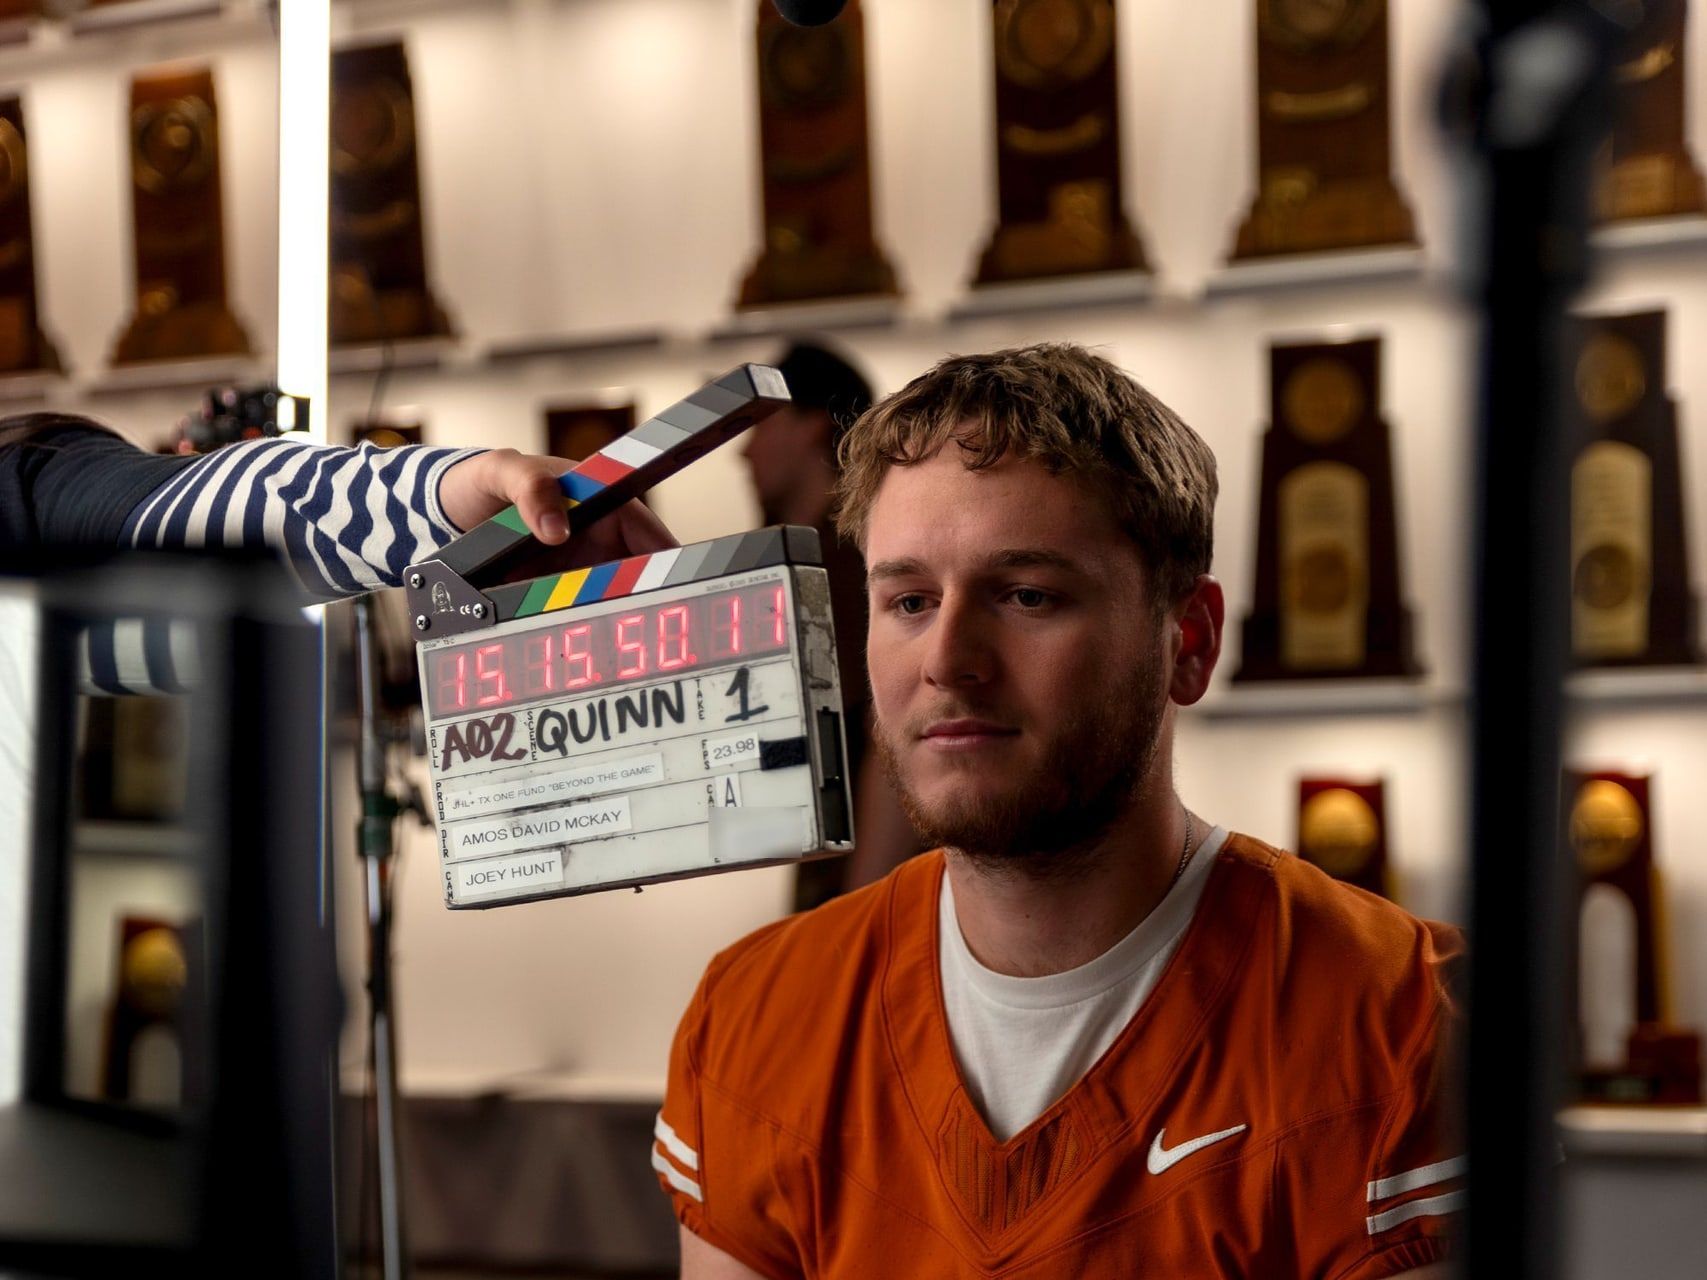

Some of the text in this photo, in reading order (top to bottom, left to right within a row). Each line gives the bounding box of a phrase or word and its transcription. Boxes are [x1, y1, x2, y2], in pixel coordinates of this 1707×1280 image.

[696, 679, 705, 720] TAKE
[725, 666, 769, 722] 1
[526, 710, 537, 761] SCENE
[535, 680, 685, 757] QUINN
[430, 729, 439, 768] ROLL
[713, 738, 756, 760] 23.98
[436, 782, 446, 821] PROD
[478, 796, 491, 804] TX
[493, 790, 515, 802] ONE
[518, 785, 546, 797] FUND
[597, 770, 618, 782] THE
[706, 784, 715, 808] CA
[441, 829, 449, 859] DIR
[462, 809, 622, 847] AMOS DAVID MCKAY
[445, 871, 454, 900] CAM
[466, 859, 556, 886] JOEY HUNT
